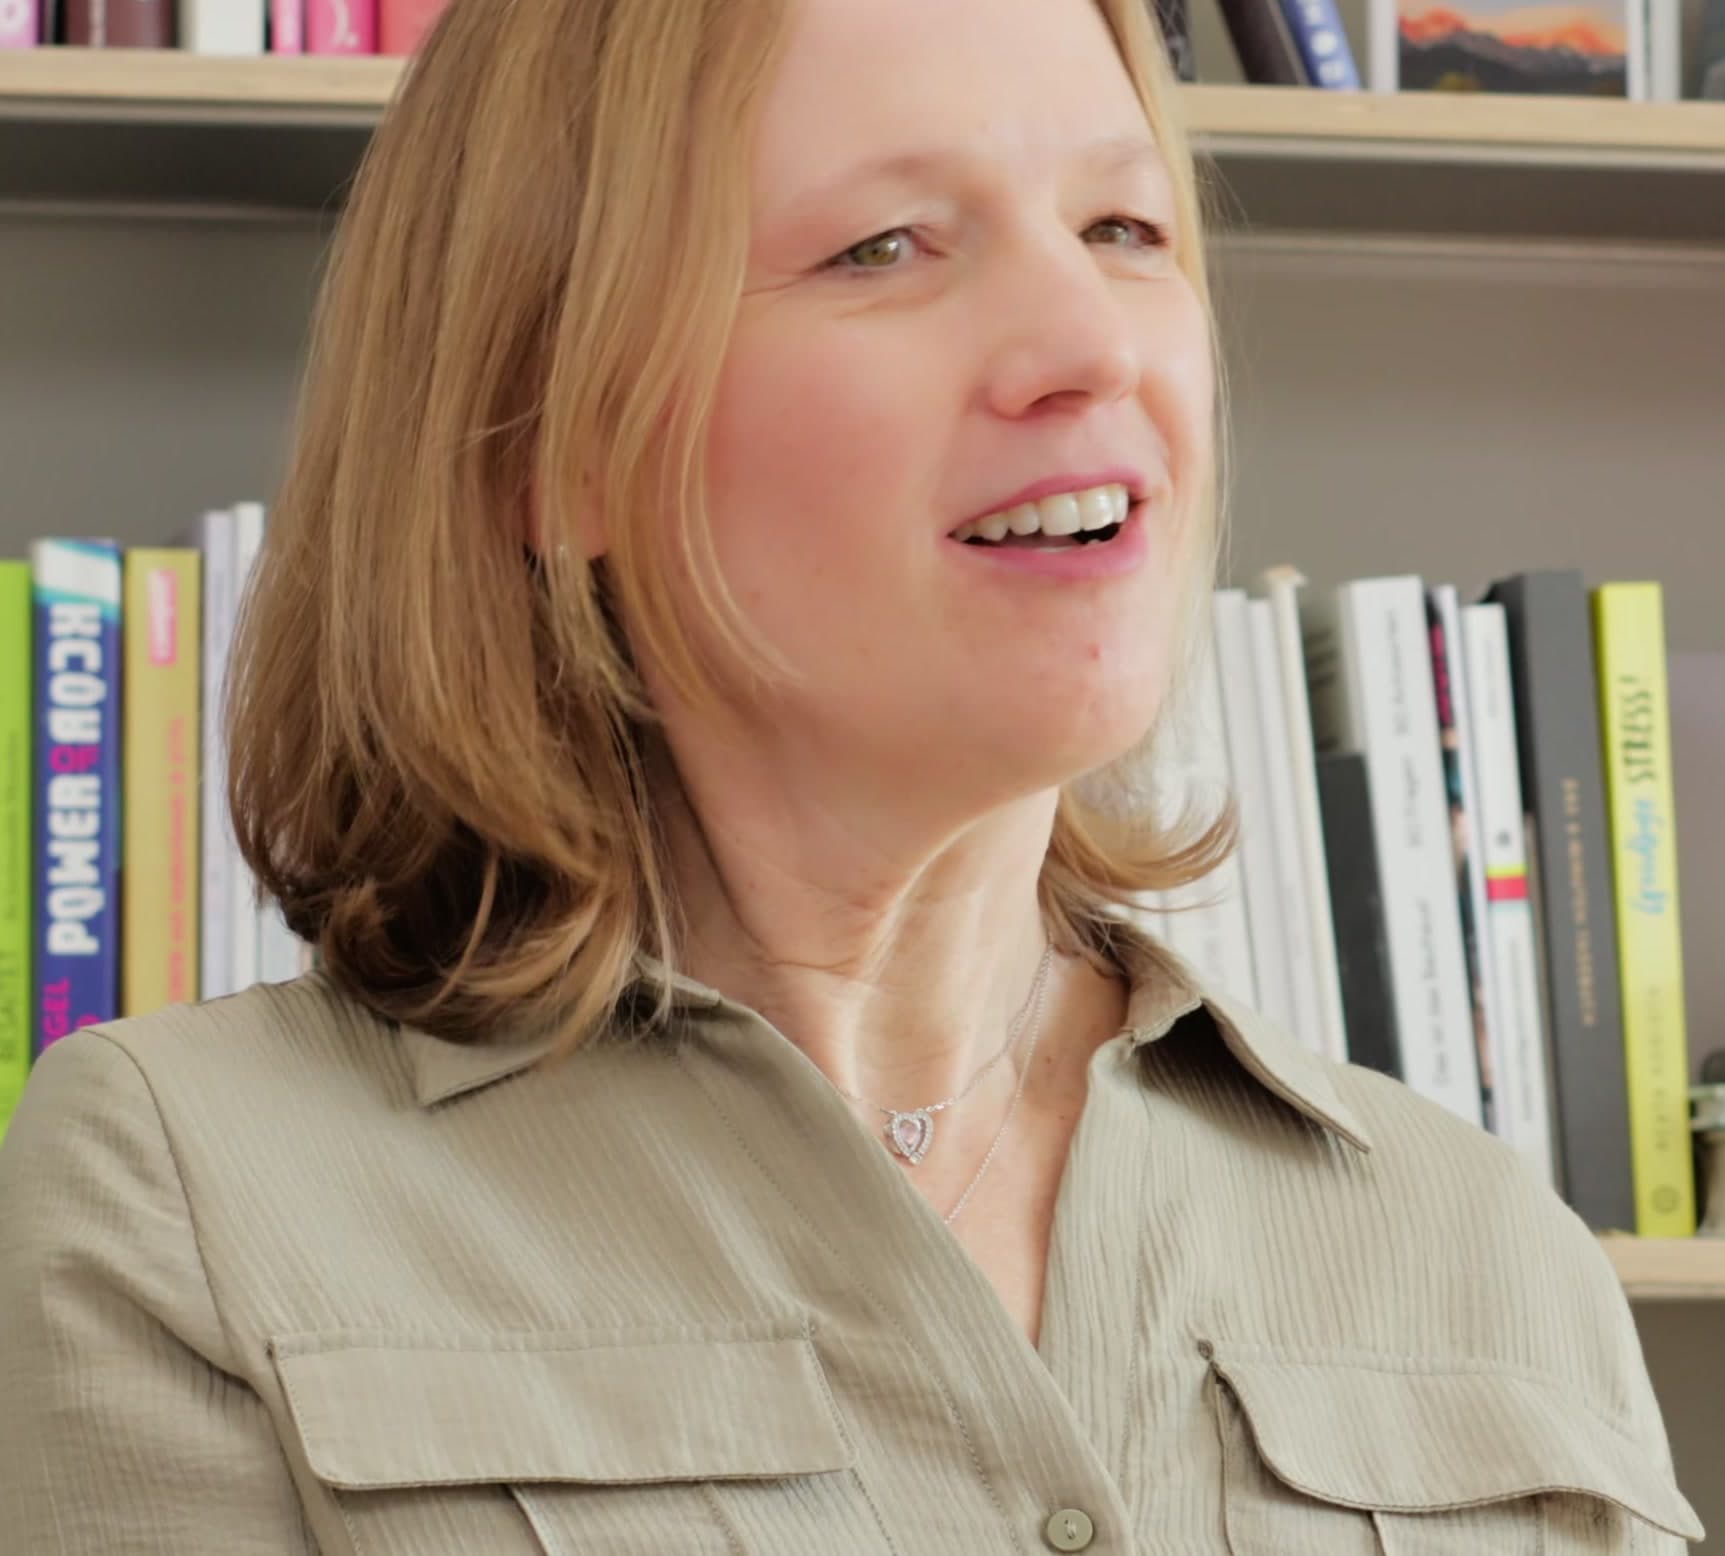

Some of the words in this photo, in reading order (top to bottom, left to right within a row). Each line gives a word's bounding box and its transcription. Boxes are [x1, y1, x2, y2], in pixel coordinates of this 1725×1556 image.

[50, 744, 102, 775] OF
[46, 774, 105, 956] POWER
[40, 976, 72, 1049] GEL
